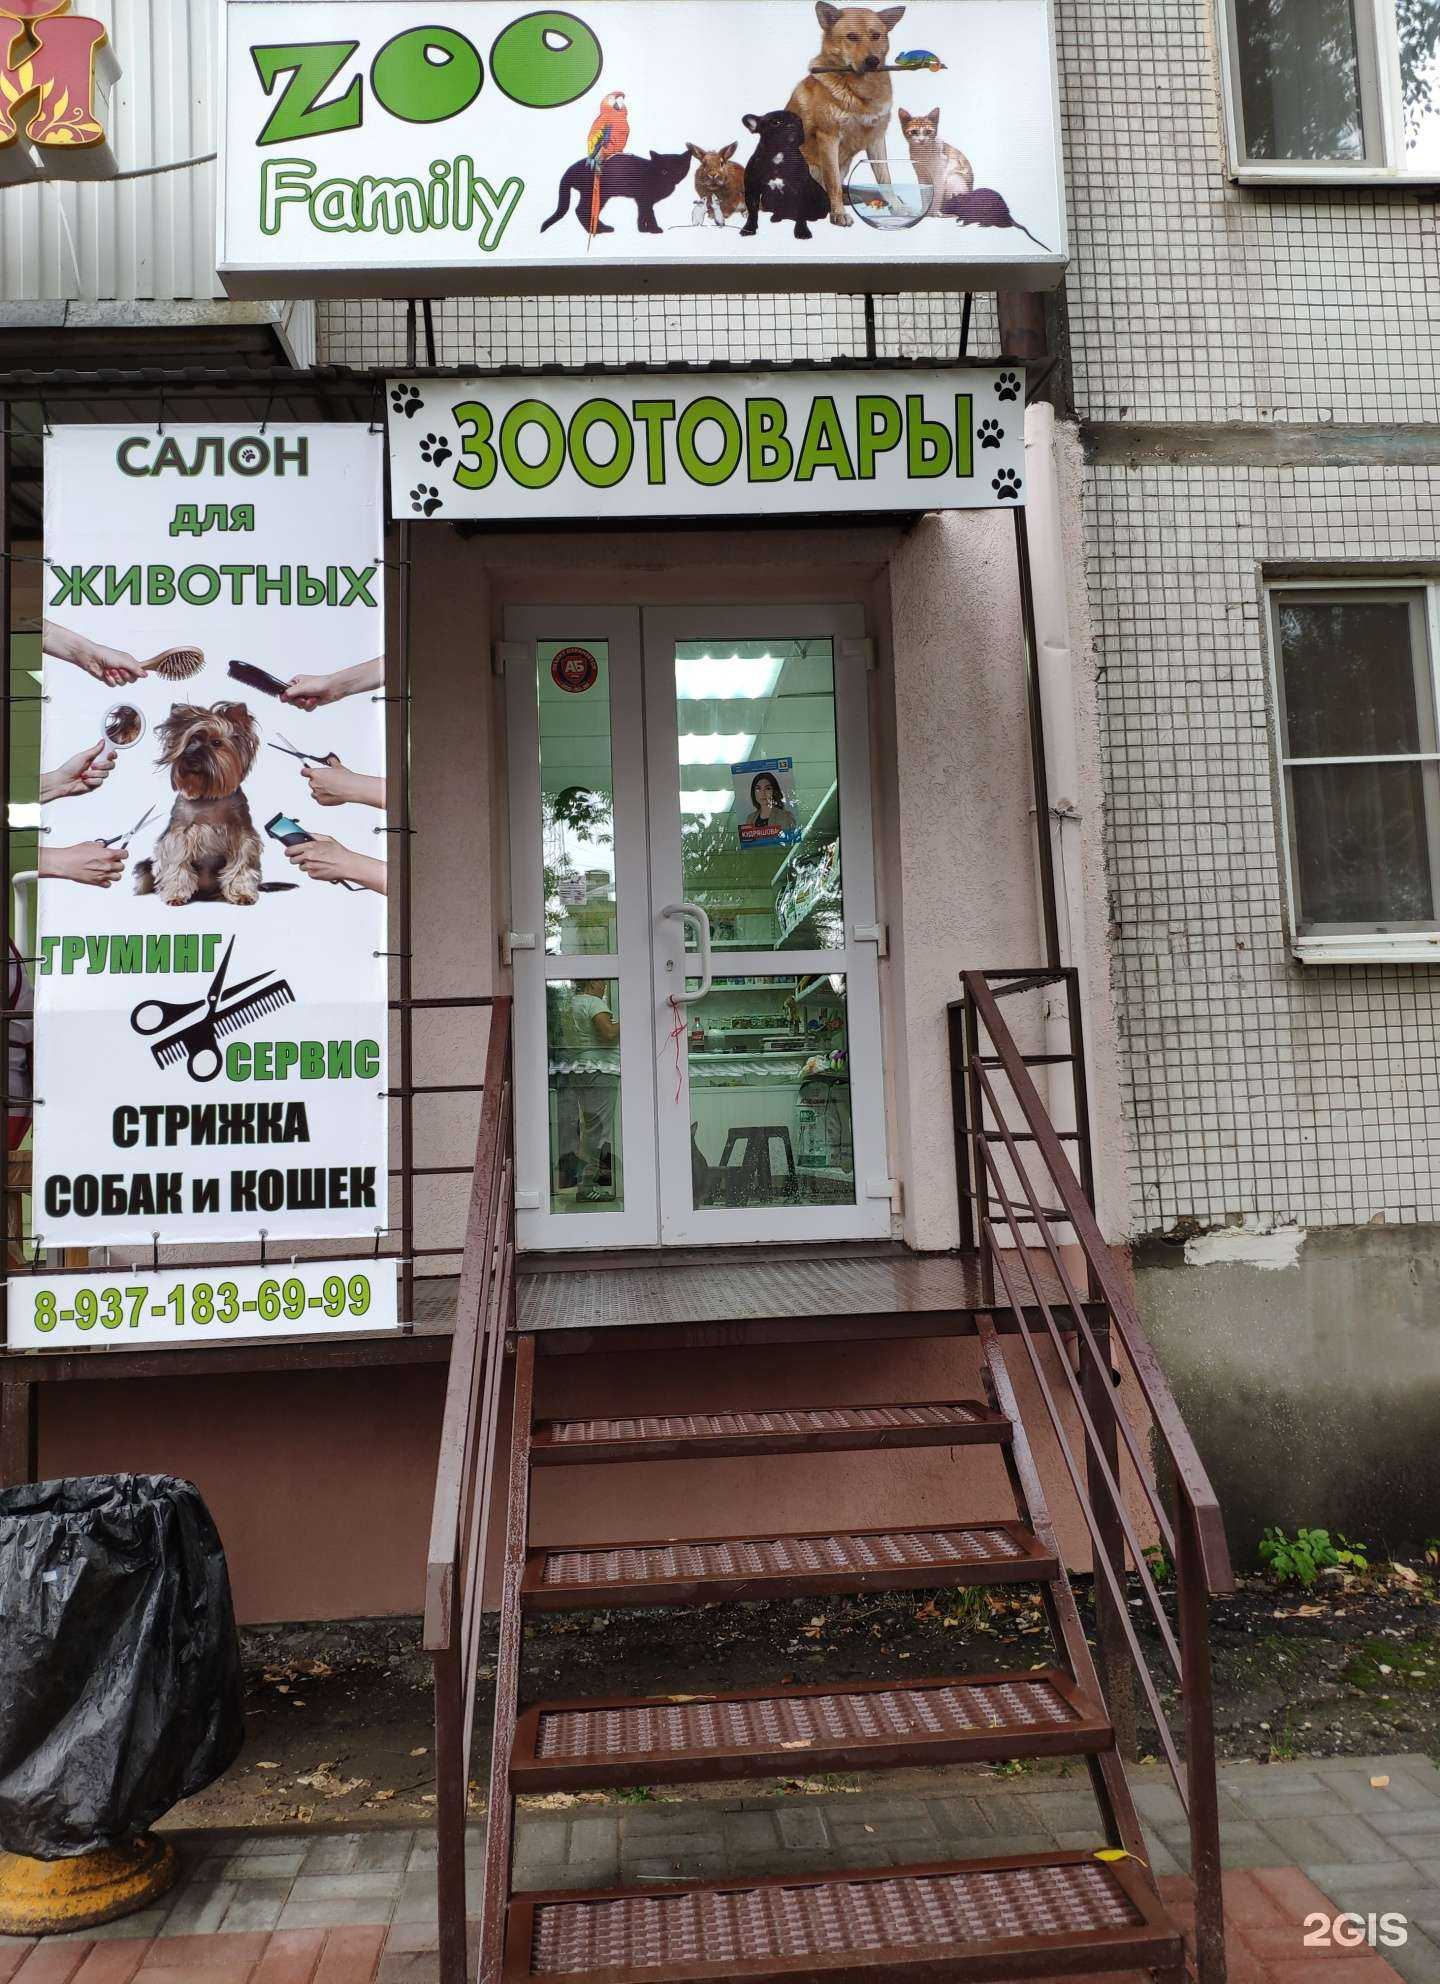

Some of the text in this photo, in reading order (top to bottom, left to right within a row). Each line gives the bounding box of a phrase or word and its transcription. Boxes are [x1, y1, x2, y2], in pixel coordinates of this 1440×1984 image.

[250, 10, 603, 146] ZOO
[260, 155, 524, 251] Family
[116, 436, 309, 477] САЛОН
[451, 393, 974, 490] ЗООТОВАРЫ
[49, 564, 378, 607] ЖИВОТНЫХ
[40, 934, 222, 975] ГРУМИНГ
[225, 1039, 380, 1082] СЕРВИС
[112, 1101, 311, 1148] СТРИЖКА
[44, 1171, 183, 1218] СОБАК
[230, 1166, 377, 1212] КОШЕК
[34, 1274, 371, 1333] 8-937-183-69-99
